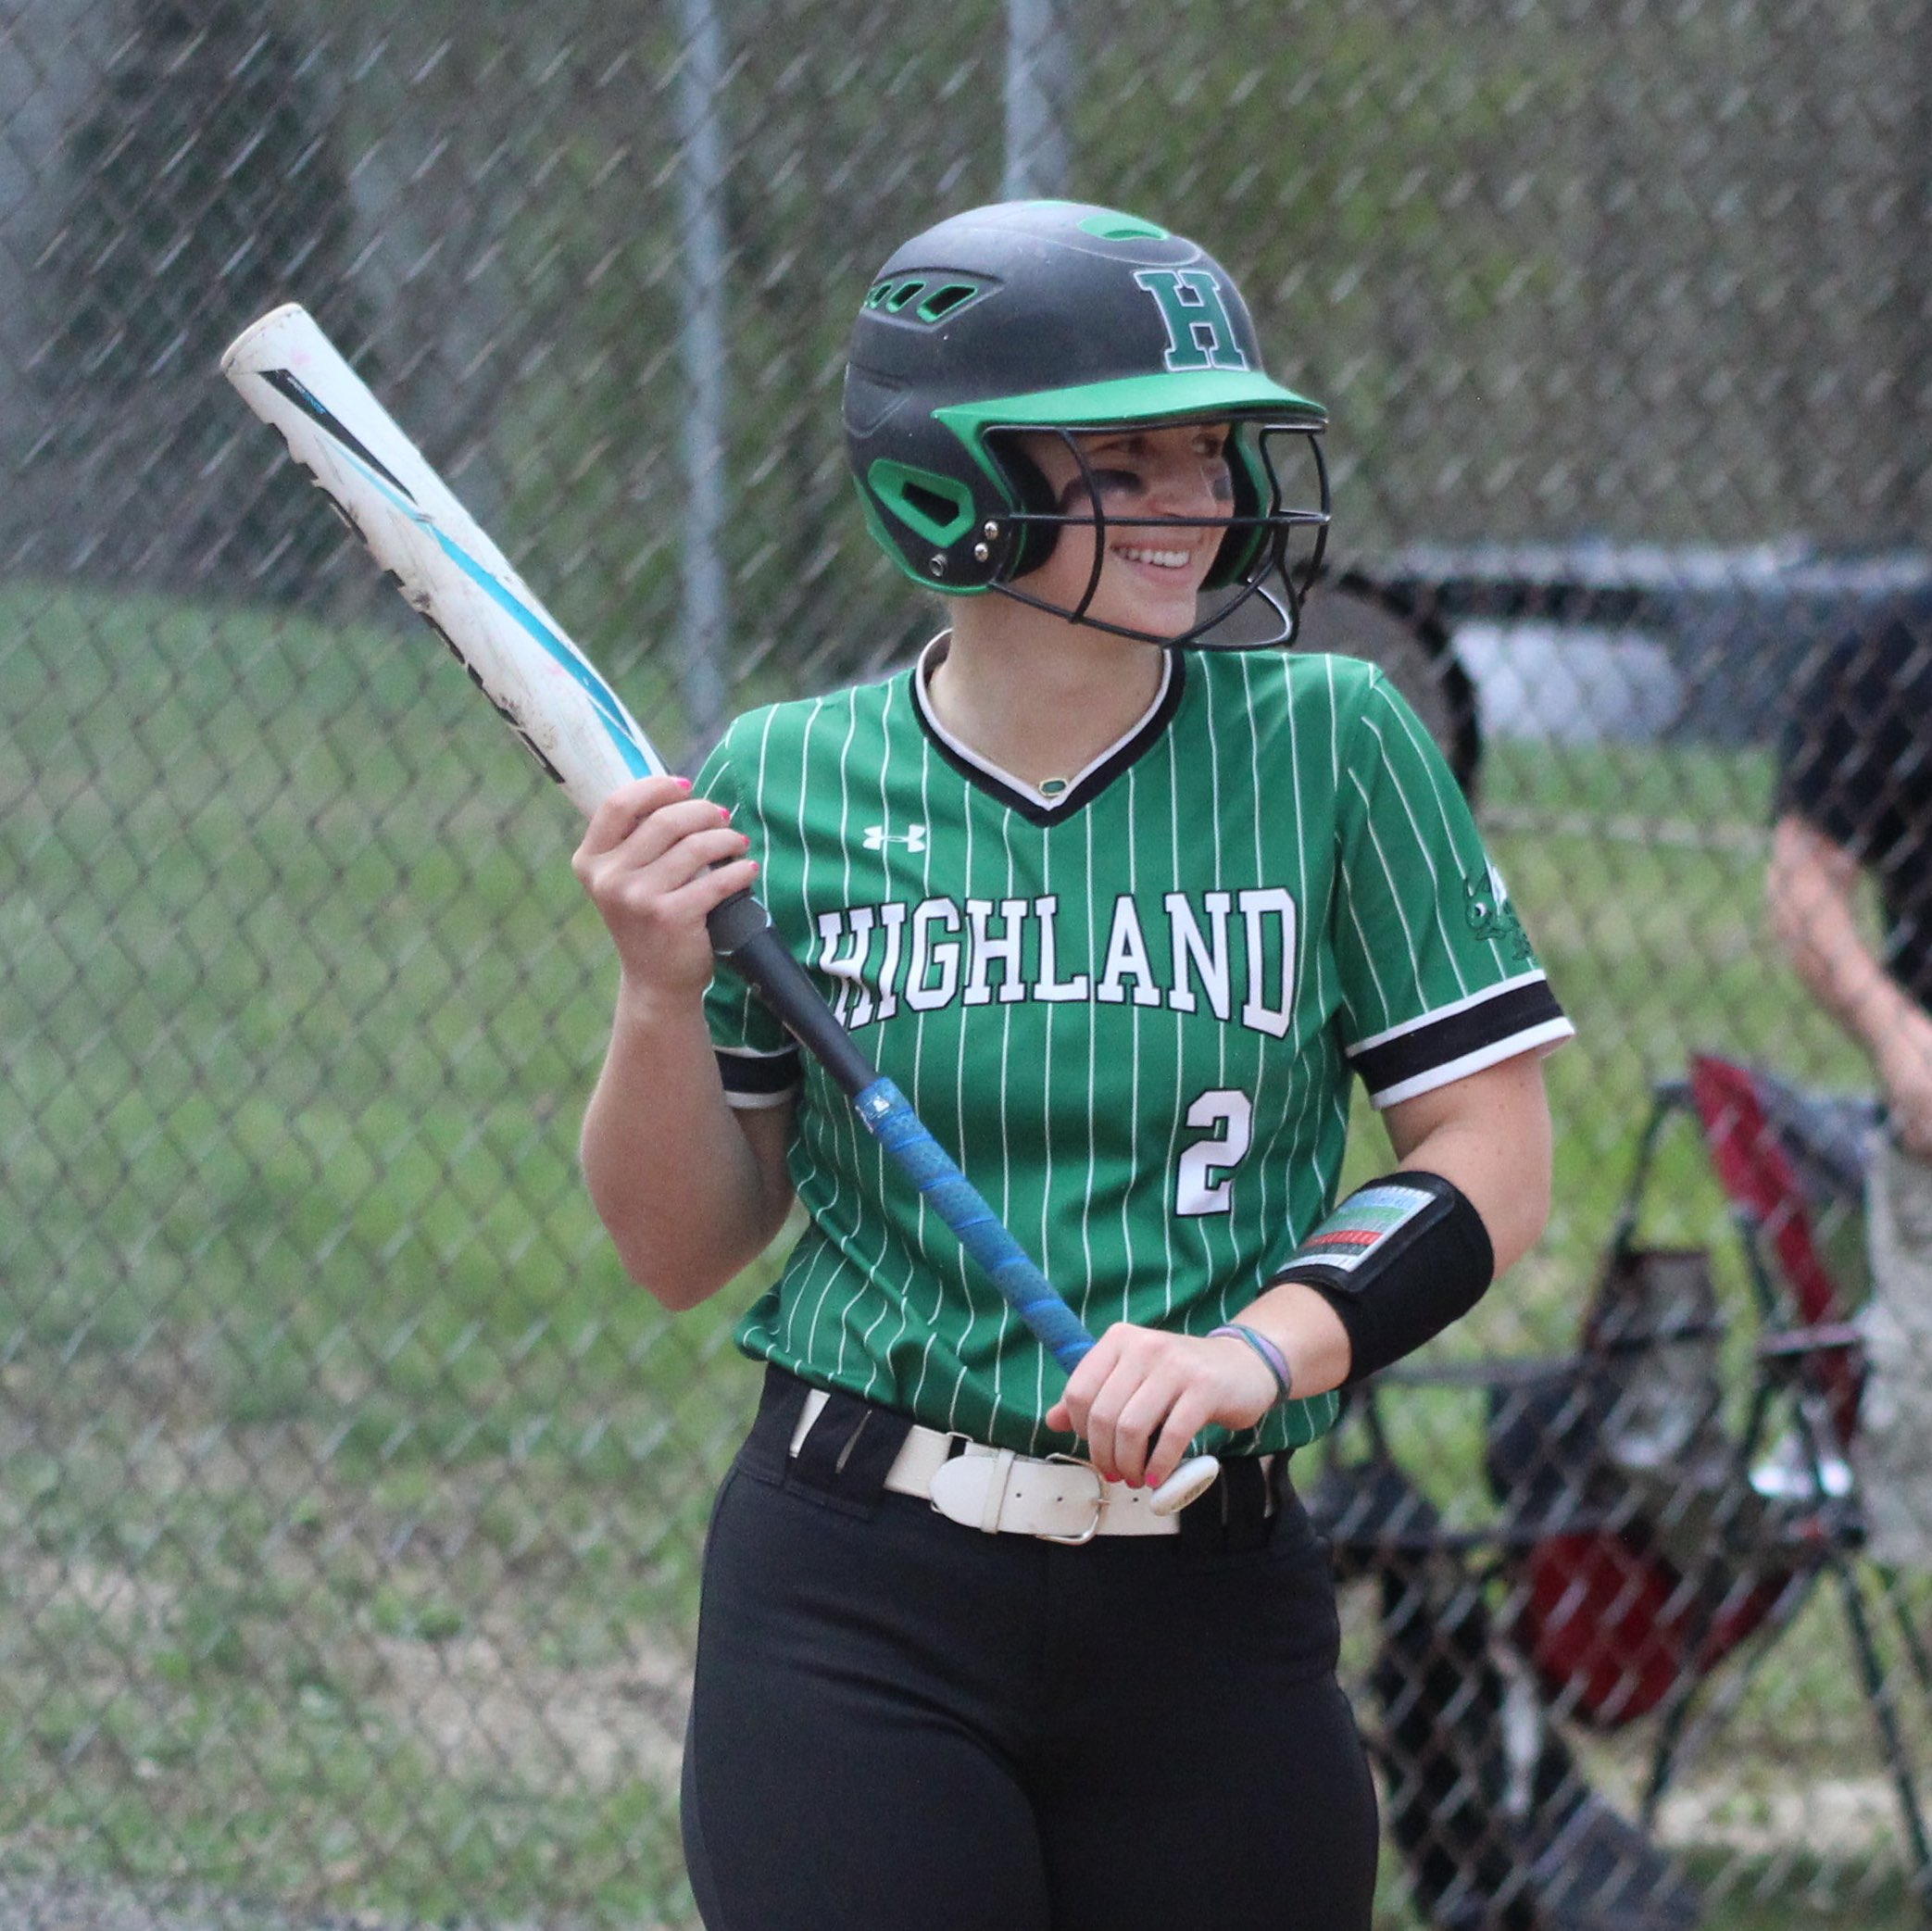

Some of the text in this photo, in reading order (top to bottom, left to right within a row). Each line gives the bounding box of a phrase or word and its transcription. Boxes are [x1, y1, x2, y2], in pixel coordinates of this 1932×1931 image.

[1133, 270, 1249, 372] H
[818, 886, 1296, 1039] HIGHLAND
[1175, 1089, 1252, 1218] 2
